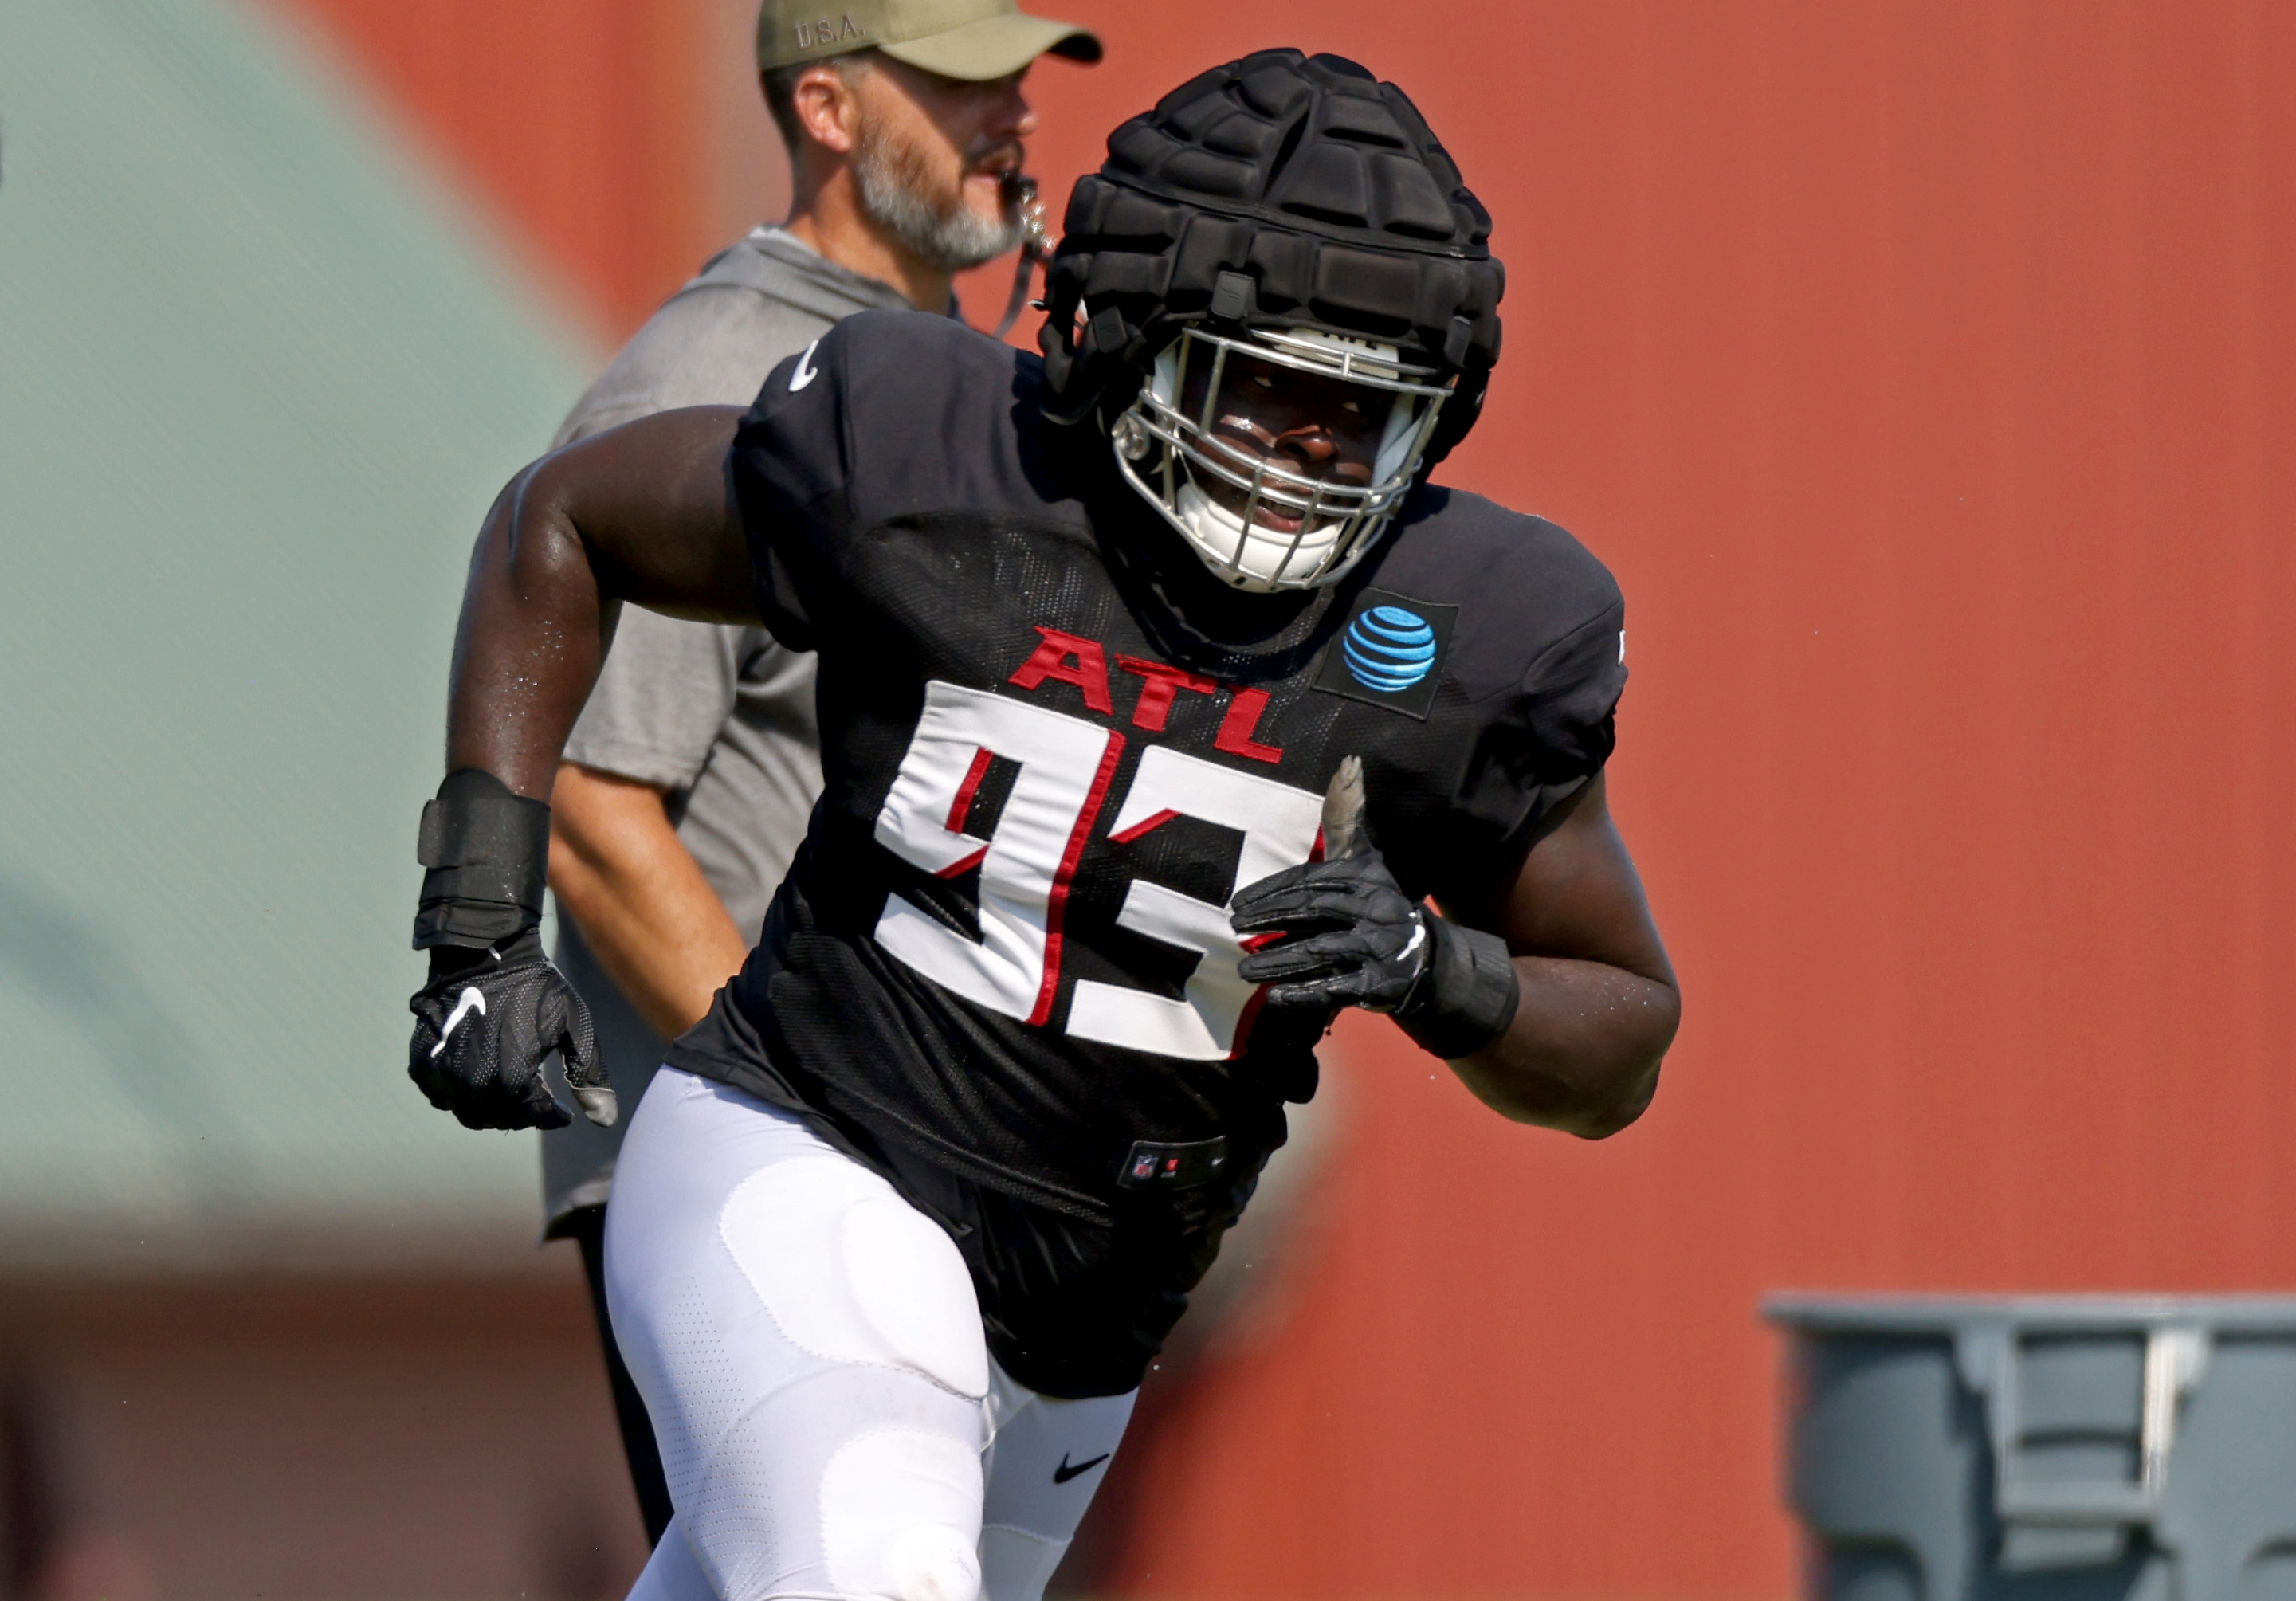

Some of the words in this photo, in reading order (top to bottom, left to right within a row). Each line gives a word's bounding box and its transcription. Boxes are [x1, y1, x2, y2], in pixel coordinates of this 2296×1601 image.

[795, 14, 866, 48] U.S.A.
[1008, 625, 1284, 764] ATL
[873, 679, 1327, 1061] 93
